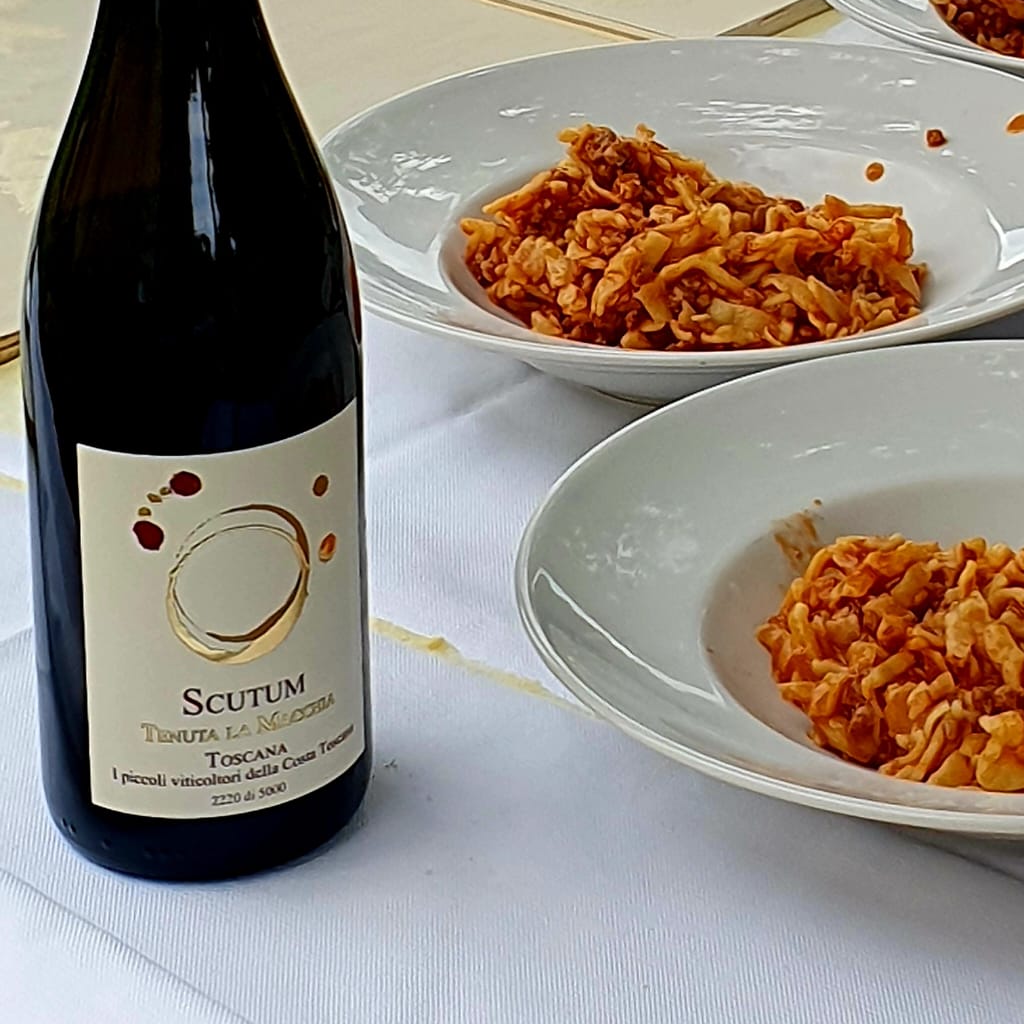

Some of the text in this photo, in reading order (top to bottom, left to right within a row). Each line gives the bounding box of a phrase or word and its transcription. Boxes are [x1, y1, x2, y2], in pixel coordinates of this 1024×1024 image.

[182, 673, 305, 716] SCUTUM
[141, 722, 219, 744] TENUTA
[225, 724, 251, 740] LA
[121, 770, 166, 787] piccoli
[171, 770, 242, 787] viticoltori
[245, 764, 279, 780] della
[282, 751, 316, 770] Costa
[204, 743, 288, 769] TOSCANA
[244, 791, 255, 801] di
[258, 782, 287, 799] 5000
